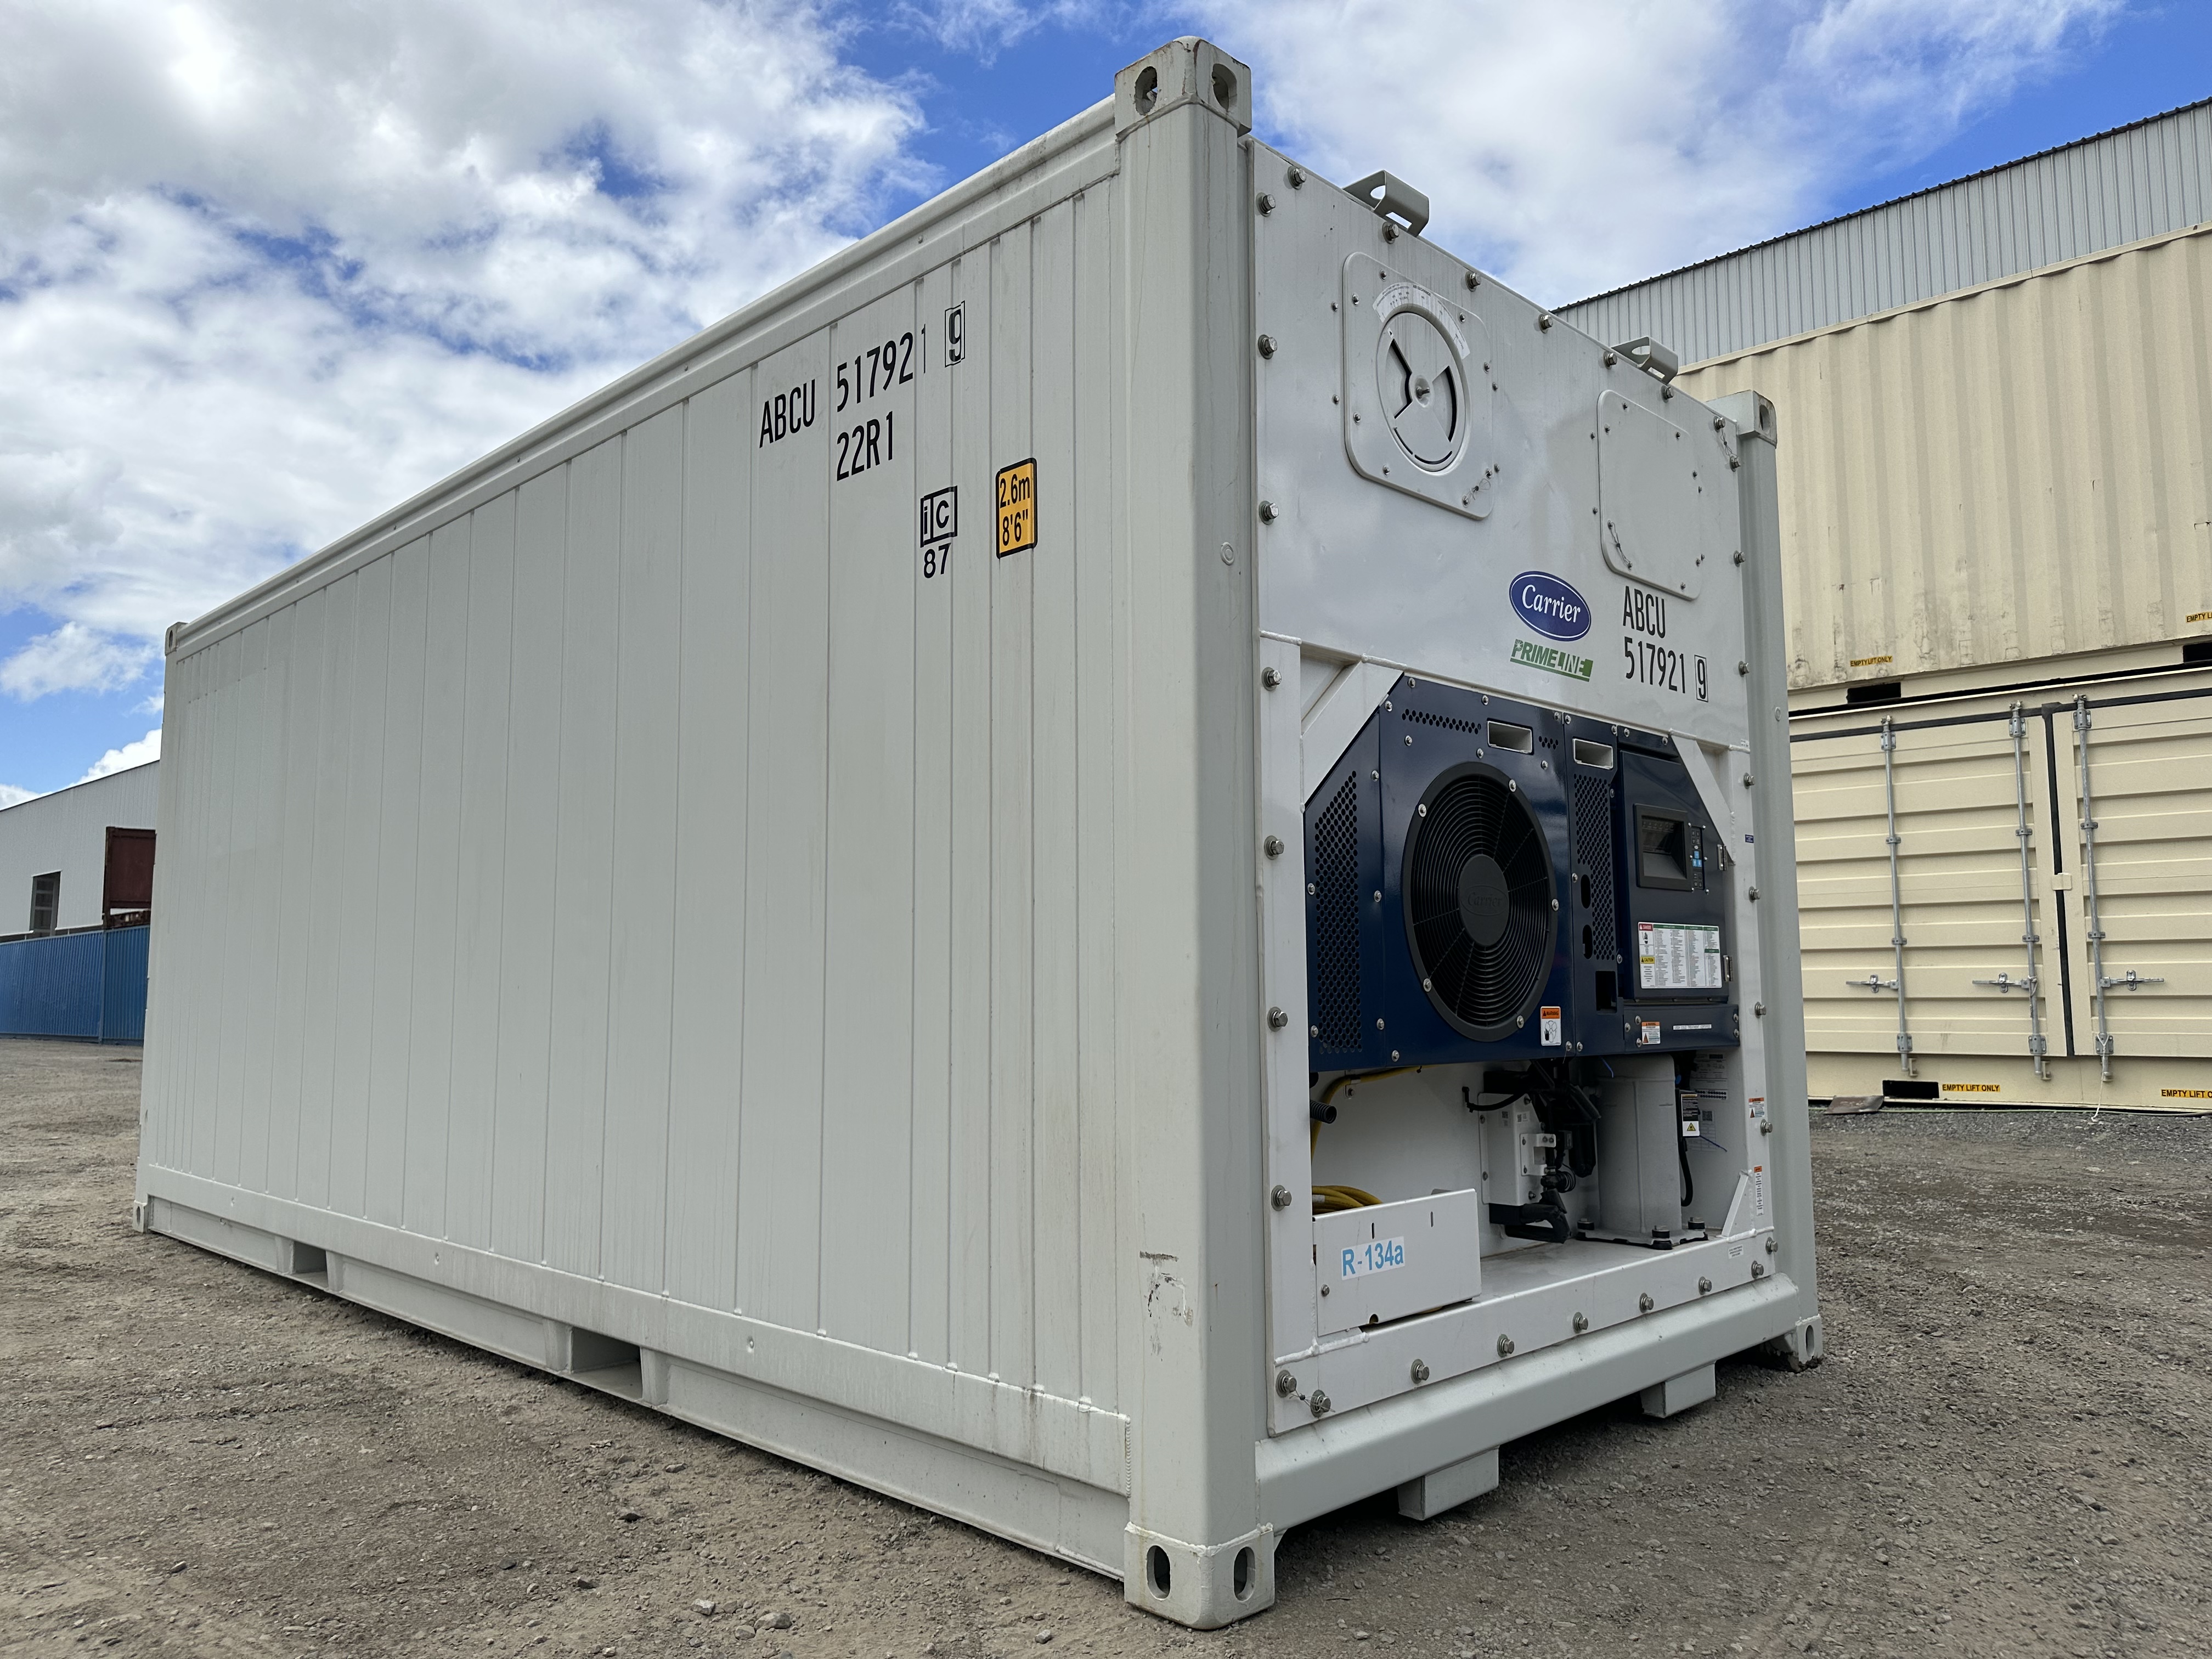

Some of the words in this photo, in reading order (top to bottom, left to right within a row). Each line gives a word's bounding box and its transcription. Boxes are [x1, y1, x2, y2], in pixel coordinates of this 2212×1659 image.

[759, 379, 816, 448] ABCU
[837, 323, 926, 412] 517921
[947, 307, 963, 363] 9
[836, 411, 893, 481] 22R1
[999, 473, 1031, 508] 2.6m
[1002, 509, 1029, 546] 8'6"
[923, 543, 951, 579] 87
[1521, 584, 1581, 623] Carrier
[1623, 586, 1666, 639] ABCU
[2186, 613, 2205, 622] EMPTY
[1511, 639, 1593, 678] PRIMELINE
[1624, 636, 1686, 693] 517921
[1696, 658, 1707, 699] 9
[1468, 892, 1502, 907] Carrier
[1342, 1240, 1404, 1277] R-134a
